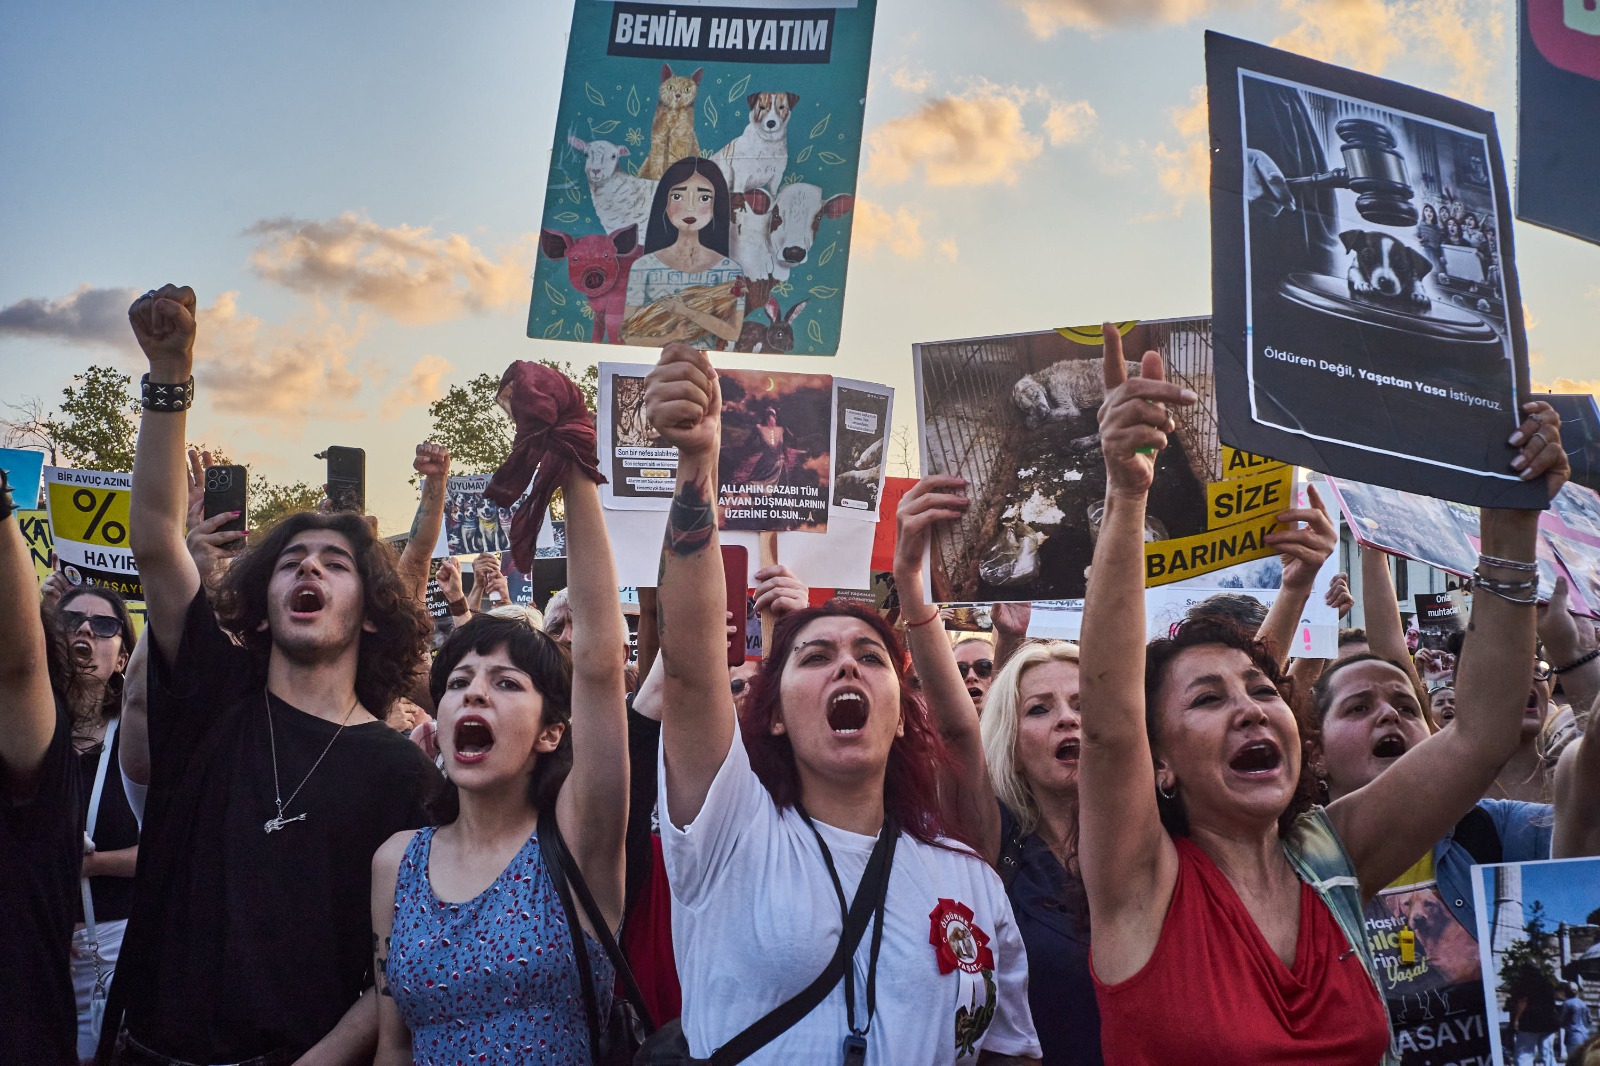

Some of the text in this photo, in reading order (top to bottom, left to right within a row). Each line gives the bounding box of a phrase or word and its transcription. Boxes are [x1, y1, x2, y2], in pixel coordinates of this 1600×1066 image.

[614, 9, 829, 51] BENİM HAYATIM
[1264, 346, 1503, 411] Öldüren Değil, Yaşatan Yasa İstiyoruz.
[57, 471, 73, 482] BİR
[75, 475, 102, 486] AVUÇ
[720, 484, 819, 497] ALLAHIN GAZABI TÜM
[1214, 479, 1283, 519] SİZE
[754, 495, 826, 510] DÜŞMANLARININ
[724, 508, 806, 521] ÜZERİNE OLSUN...
[84, 550, 139, 572] HAYIR
[1386, 957, 1430, 990] Yaşat
